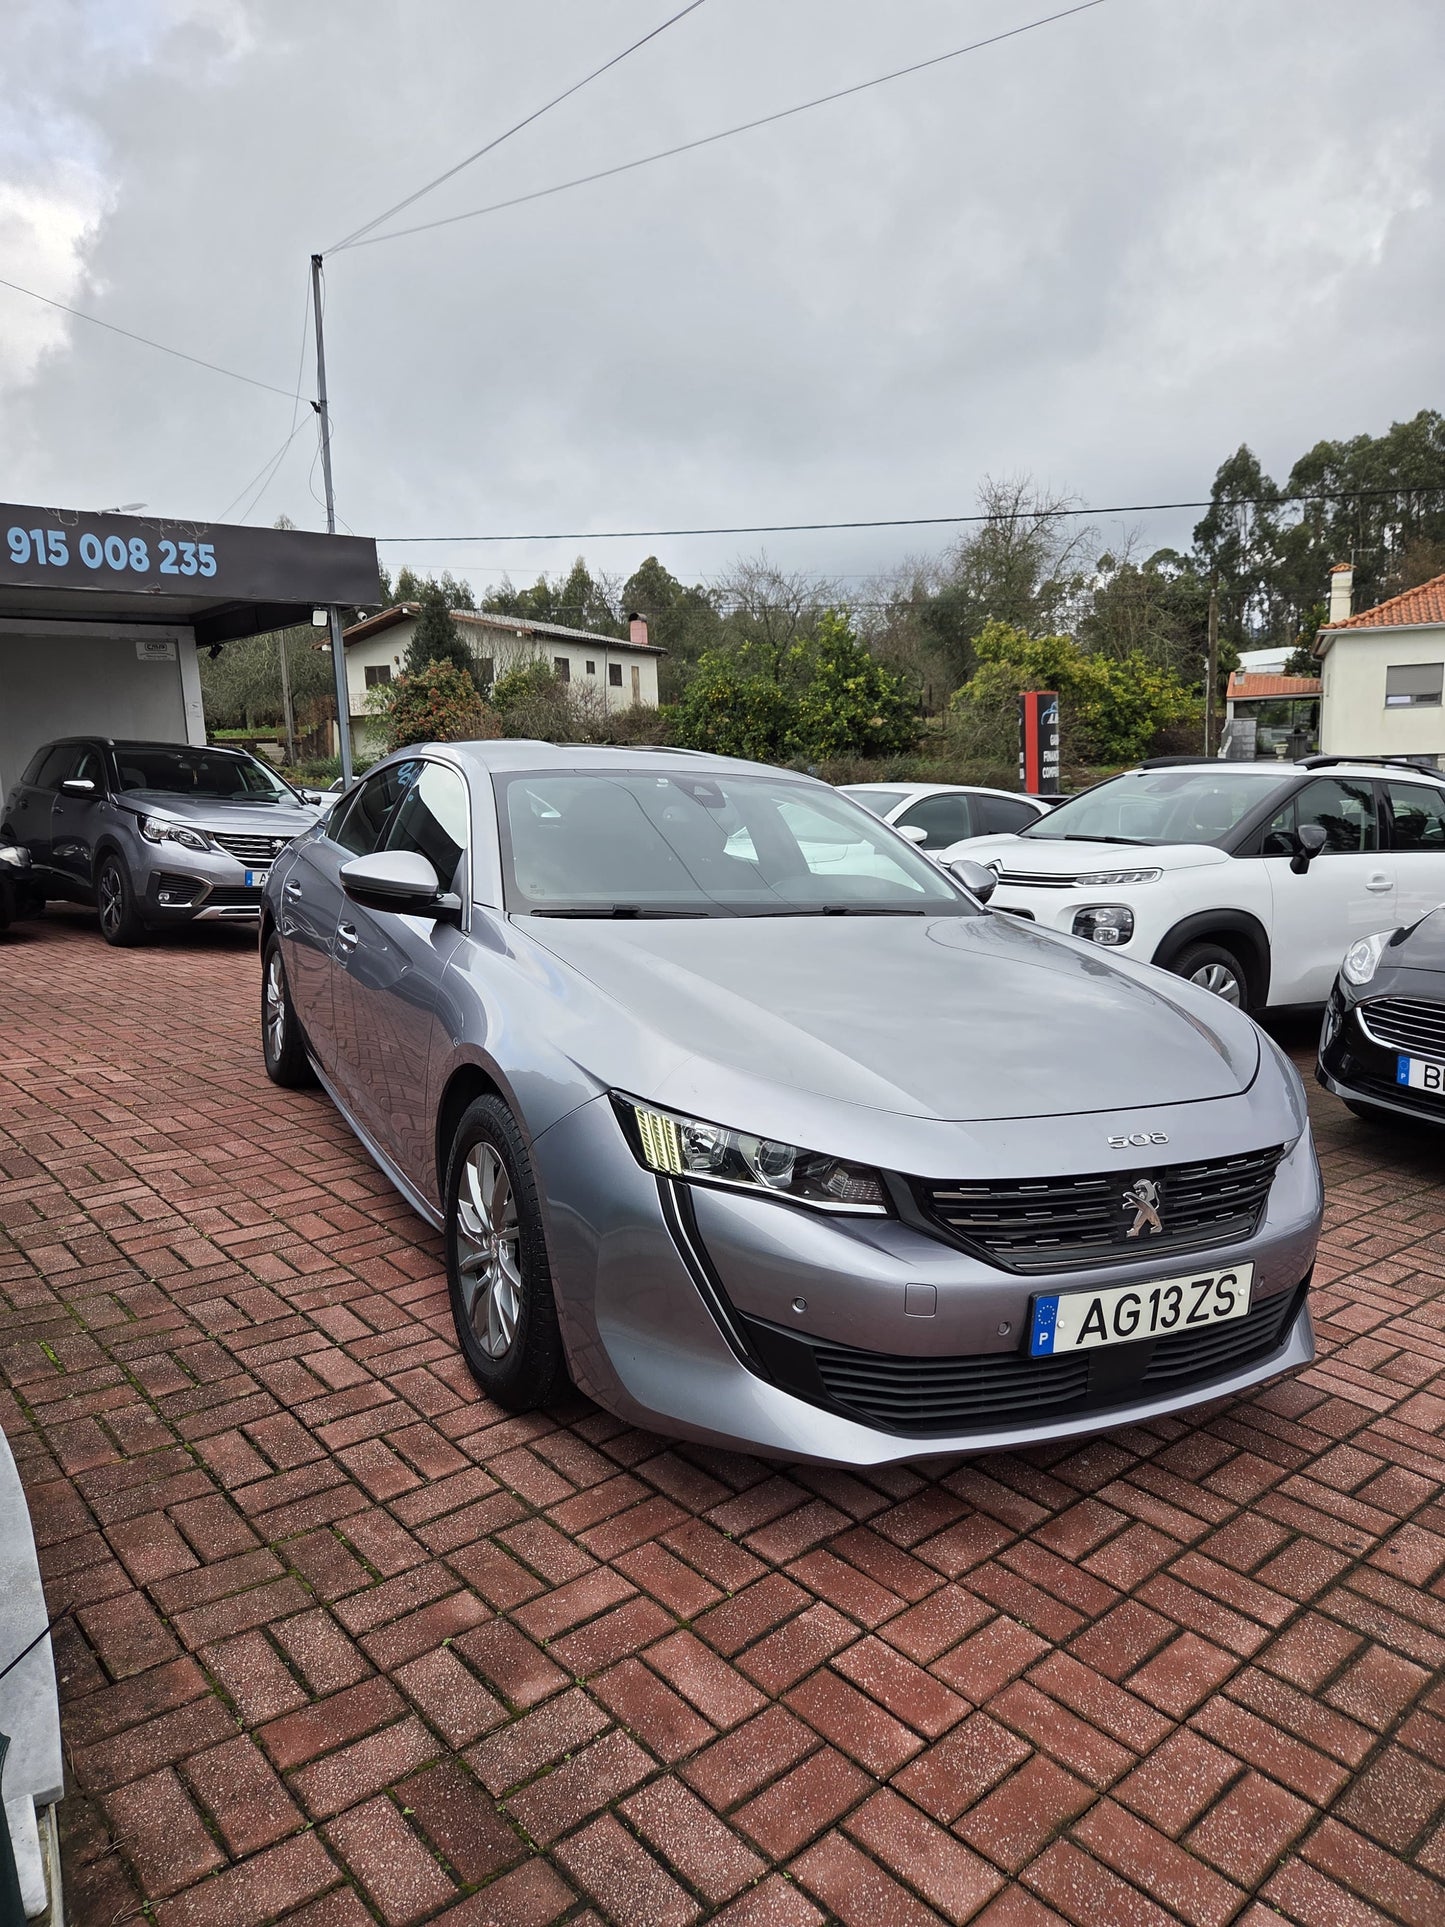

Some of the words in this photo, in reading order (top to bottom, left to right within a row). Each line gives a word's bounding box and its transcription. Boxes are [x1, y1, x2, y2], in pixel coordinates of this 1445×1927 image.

[7, 527, 69, 566] 915
[79, 533, 150, 572] 008
[158, 540, 217, 577] 235
[1424, 1064, 1445, 1091] B
[1107, 1131, 1169, 1149] 508
[1039, 1332, 1049, 1346] P
[1076, 1274, 1237, 1344] AG13ZS
